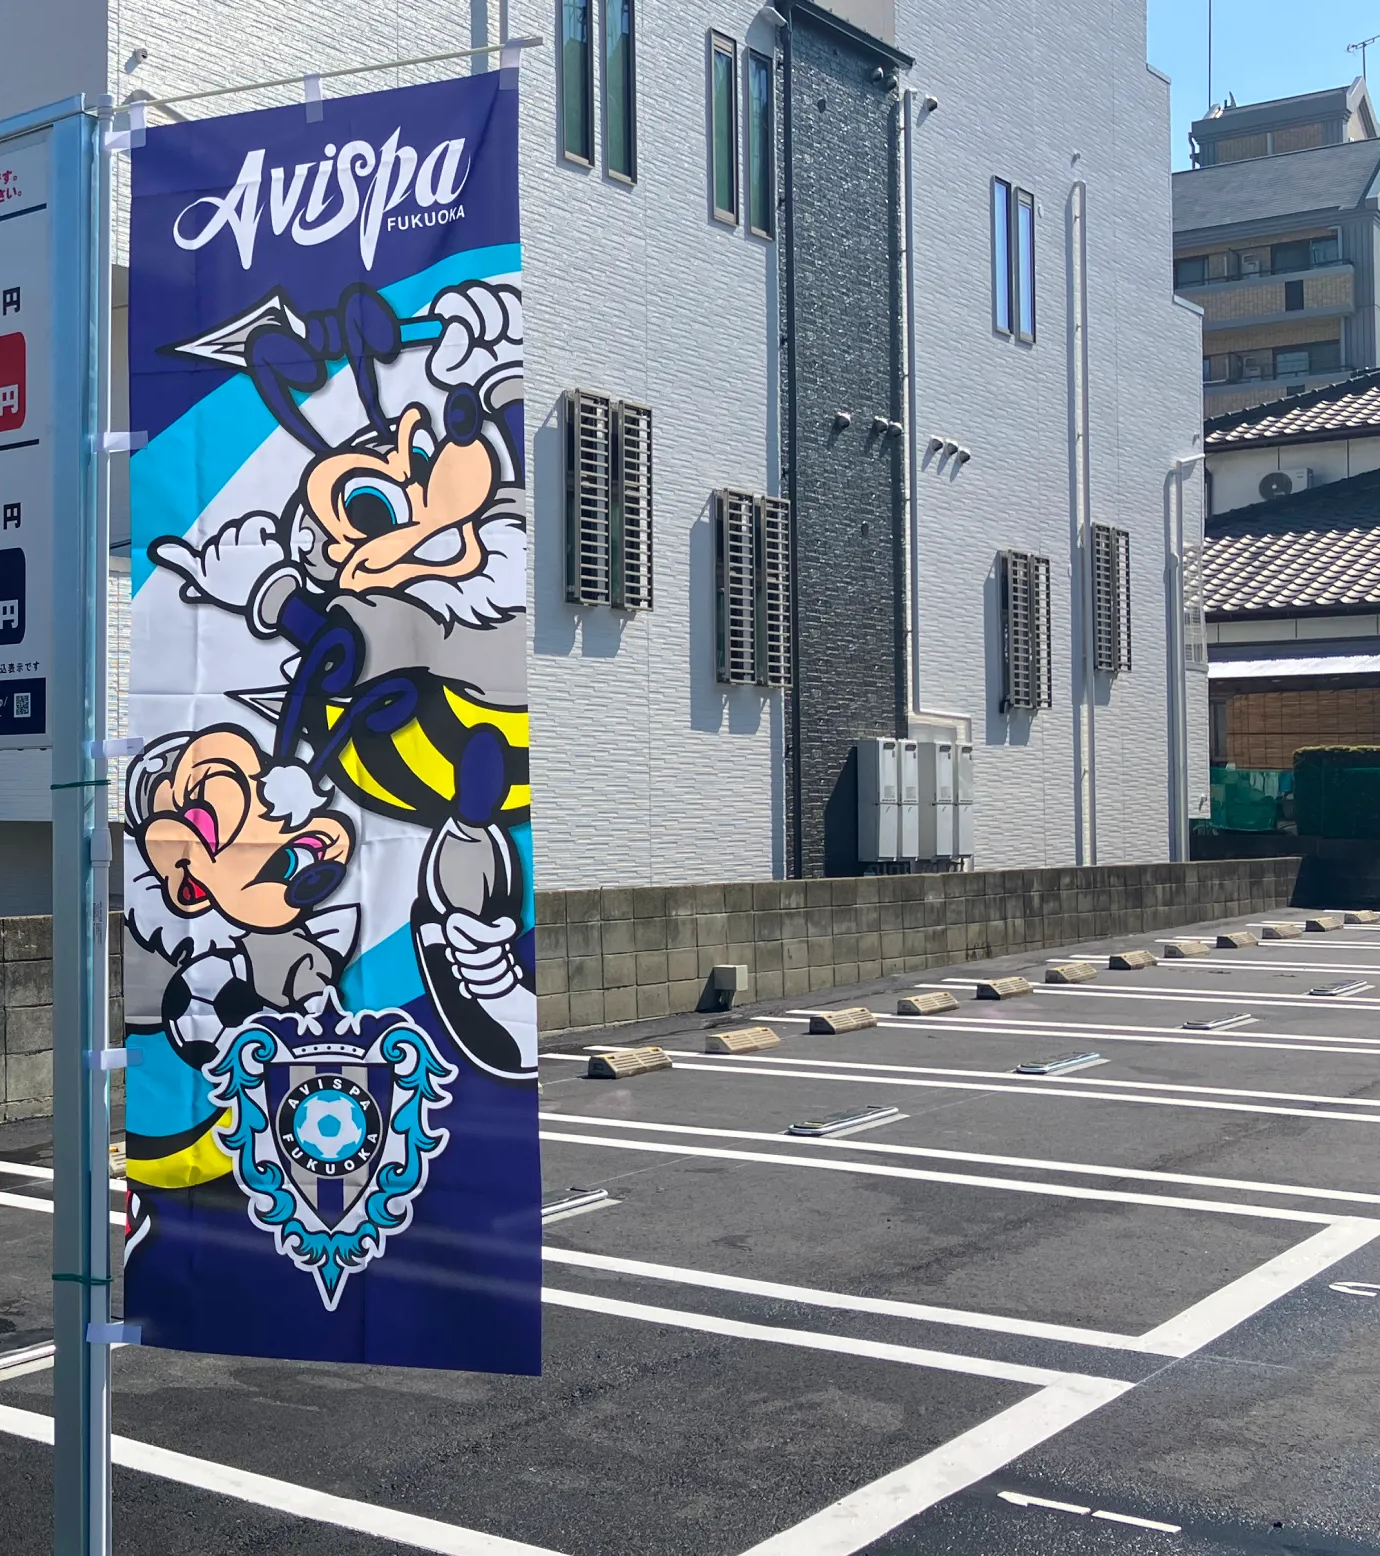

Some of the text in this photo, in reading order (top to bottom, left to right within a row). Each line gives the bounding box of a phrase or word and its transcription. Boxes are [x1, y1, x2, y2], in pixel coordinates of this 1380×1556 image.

[173, 126, 470, 271] Avispa
[387, 204, 466, 232] FUKUOKA
[287, 1078, 371, 1110] AVISPA
[281, 1132, 378, 1175] FUKUOKA
